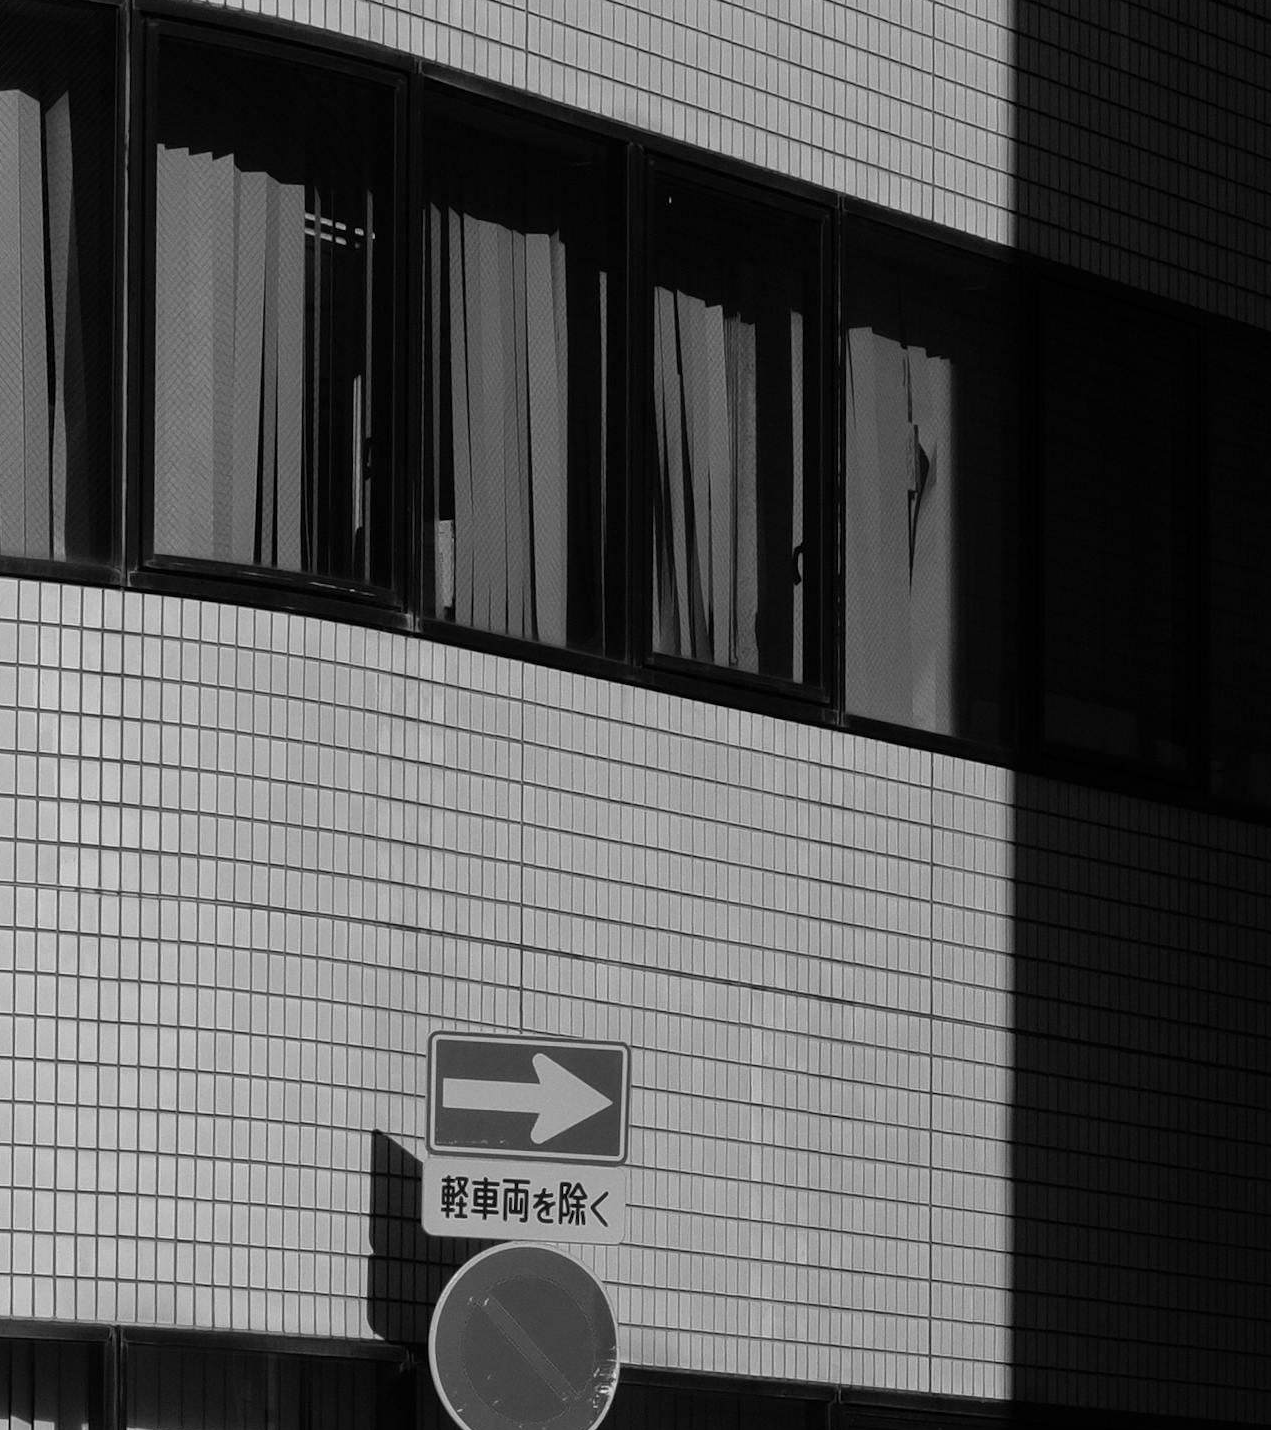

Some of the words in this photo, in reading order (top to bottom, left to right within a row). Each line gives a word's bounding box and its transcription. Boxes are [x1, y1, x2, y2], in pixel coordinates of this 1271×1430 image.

[440, 1174, 609, 1228] 軽車両を除く
